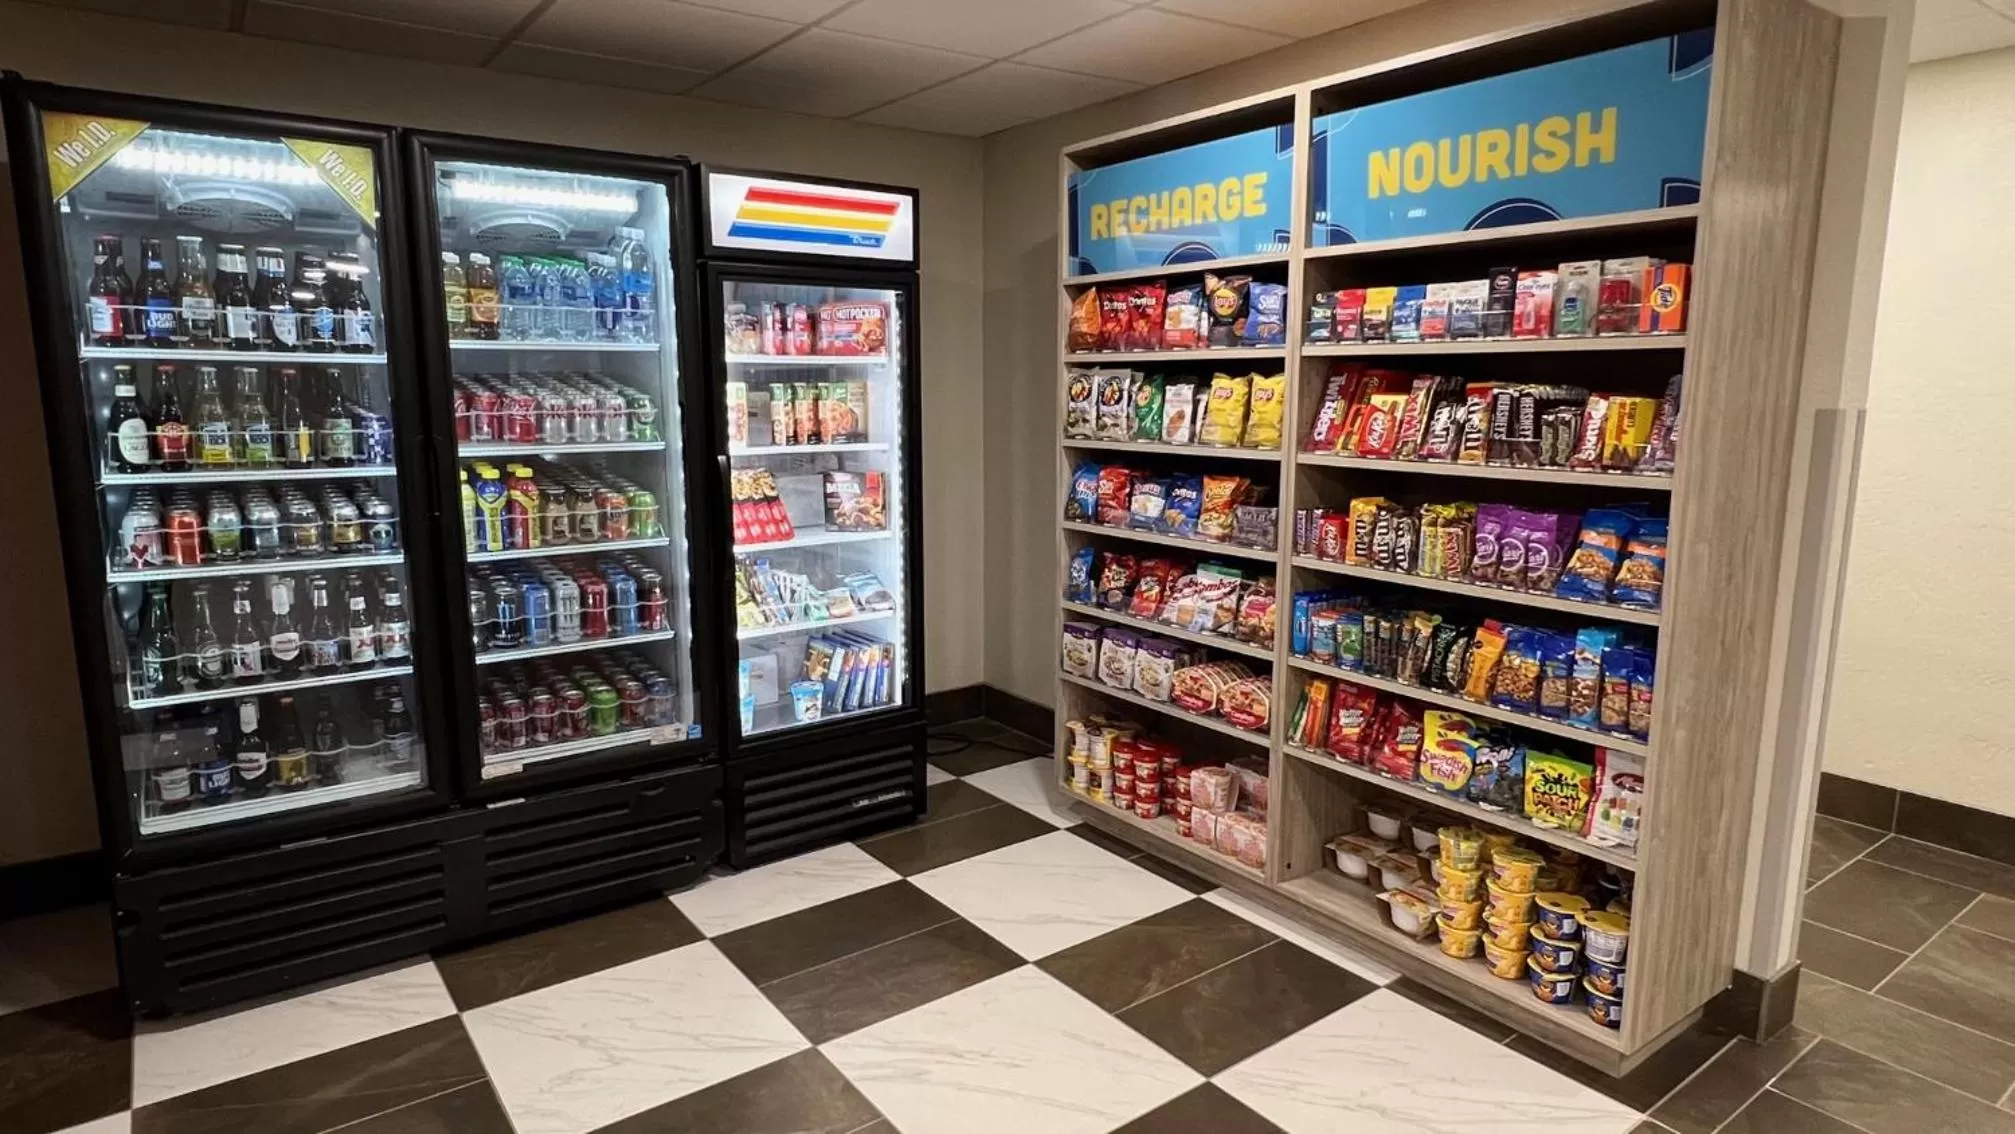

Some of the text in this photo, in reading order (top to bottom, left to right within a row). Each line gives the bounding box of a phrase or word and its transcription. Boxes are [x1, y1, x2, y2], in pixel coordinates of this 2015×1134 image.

[53, 142, 91, 168] We
[319, 148, 346, 178] We
[1368, 106, 1617, 199] NOURISH
[1090, 172, 1268, 240] RECHARGE
[1420, 749, 1468, 774] Swedish
[1431, 763, 1455, 781] Fish
[1535, 779, 1579, 798] SOUR
[1533, 793, 1580, 811] PATCH
